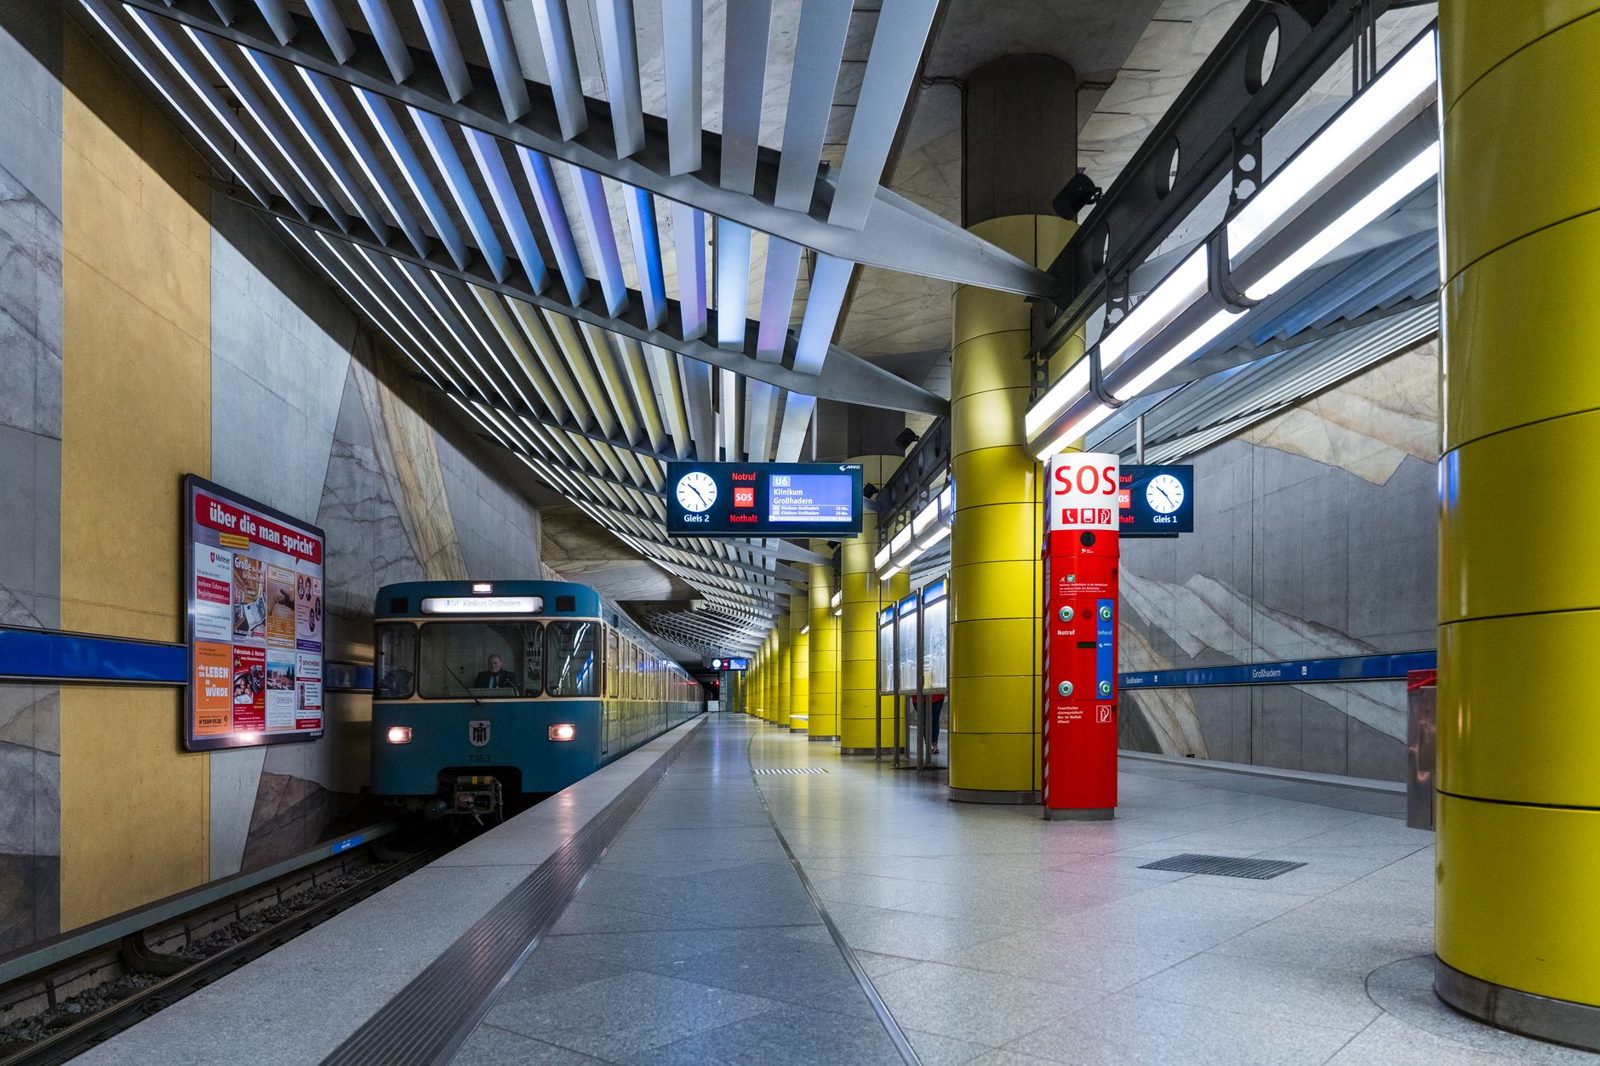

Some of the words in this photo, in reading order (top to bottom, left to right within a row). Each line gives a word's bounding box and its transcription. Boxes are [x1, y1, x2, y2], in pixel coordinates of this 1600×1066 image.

[732, 472, 756, 480] Notruf
[1054, 465, 1116, 496] SOS
[1119, 474, 1133, 483] truf
[775, 477, 788, 485] U6
[735, 494, 752, 502] SOS
[684, 514, 702, 523] Gleis
[730, 514, 758, 523] Nothalt
[1119, 514, 1134, 524] halt
[209, 502, 236, 528] über
[240, 515, 256, 535] die
[259, 525, 280, 545] man
[282, 536, 313, 556] spricht
[206, 666, 228, 679] LEBEN
[1252, 668, 1281, 678] Großhadern
[206, 684, 228, 697] WÜRDE
